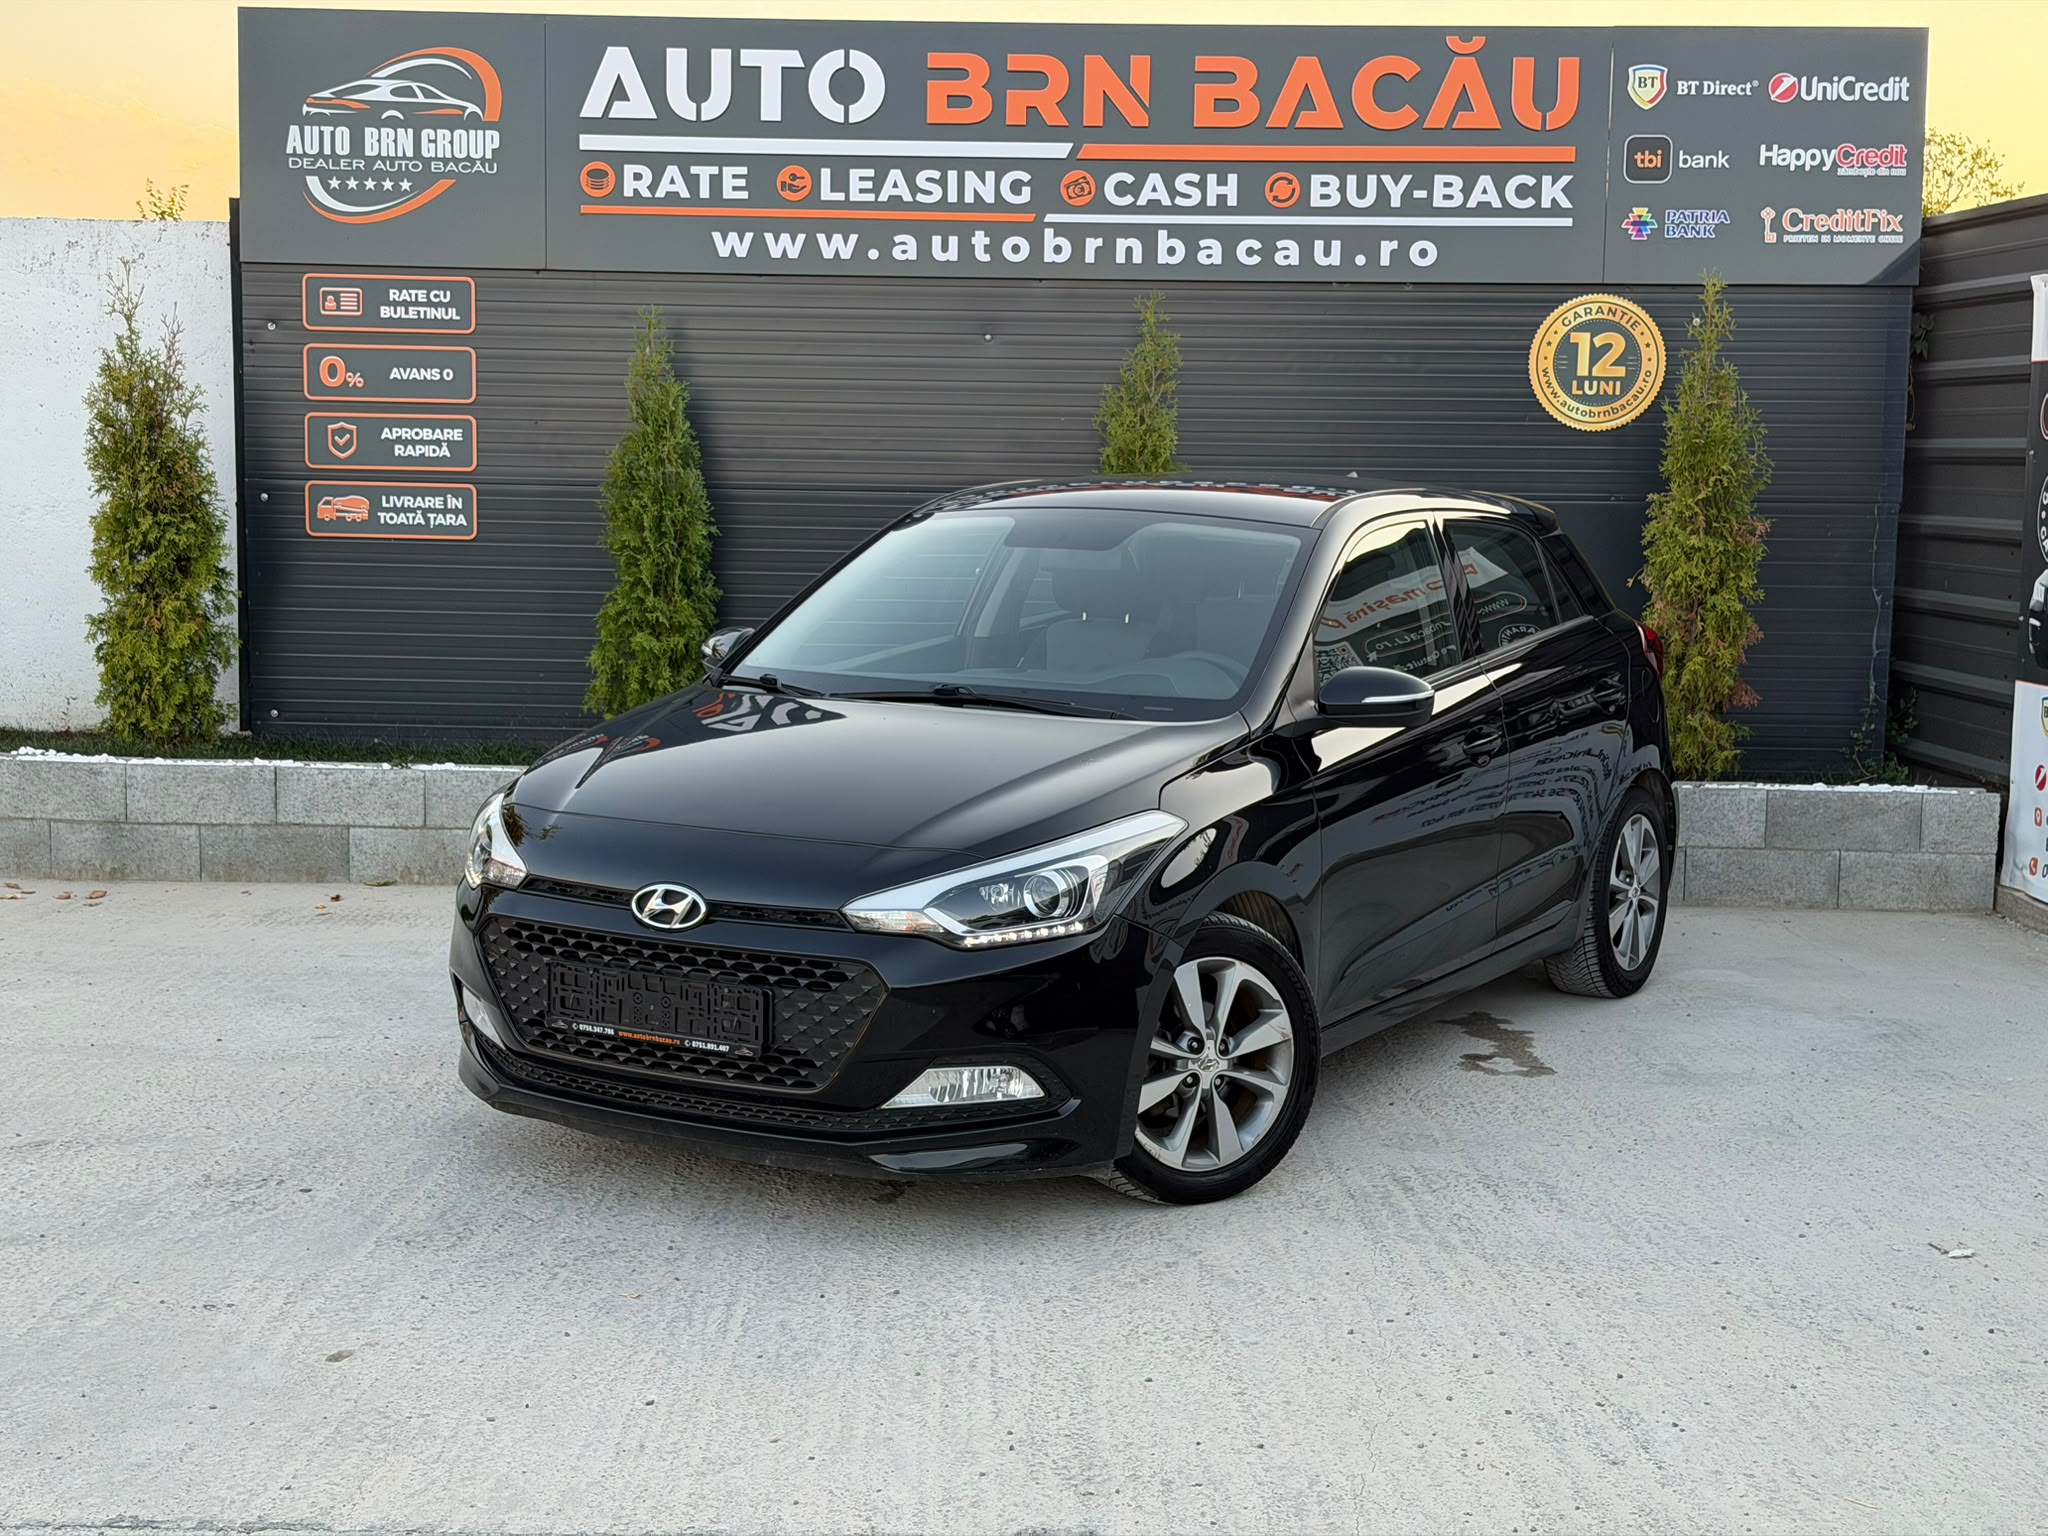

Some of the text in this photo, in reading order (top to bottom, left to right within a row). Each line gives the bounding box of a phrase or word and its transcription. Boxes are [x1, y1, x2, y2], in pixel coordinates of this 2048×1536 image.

[578, 35, 1580, 132] AUTO BRN BACĂU
[1637, 76, 1658, 89] BT
[1676, 80, 1699, 96] BT
[1800, 75, 1910, 102] UniCredit
[286, 125, 500, 160] AUTO BRN GROUP
[288, 157, 498, 174] DEALER AUTO BACĂU
[1634, 150, 1730, 169] tbi bank
[622, 164, 749, 200] RATE
[820, 167, 1033, 205] LEASING
[1103, 172, 1238, 207] CASH
[1310, 173, 1573, 209] BUY-BACK
[1664, 209, 1731, 224] PATRIA
[1782, 207, 1904, 233] CreditFix
[1664, 225, 1716, 239] BANK
[711, 228, 1439, 268] www.autobrnbacau.ro
[388, 289, 451, 303] RATE CU
[379, 306, 461, 321] BULETINUL
[1561, 305, 1640, 332] GARANTIE
[1569, 331, 1627, 378] 12
[389, 368, 441, 381] AVANS
[1541, 366, 1652, 419] www.autobrnbacau.ro
[1571, 380, 1621, 396] LUNI
[380, 427, 464, 441] APROBARE
[394, 442, 451, 458] RAPIDĂ
[381, 494, 463, 510] LIVRARE ÎN
[377, 511, 425, 526] TOATĂ
